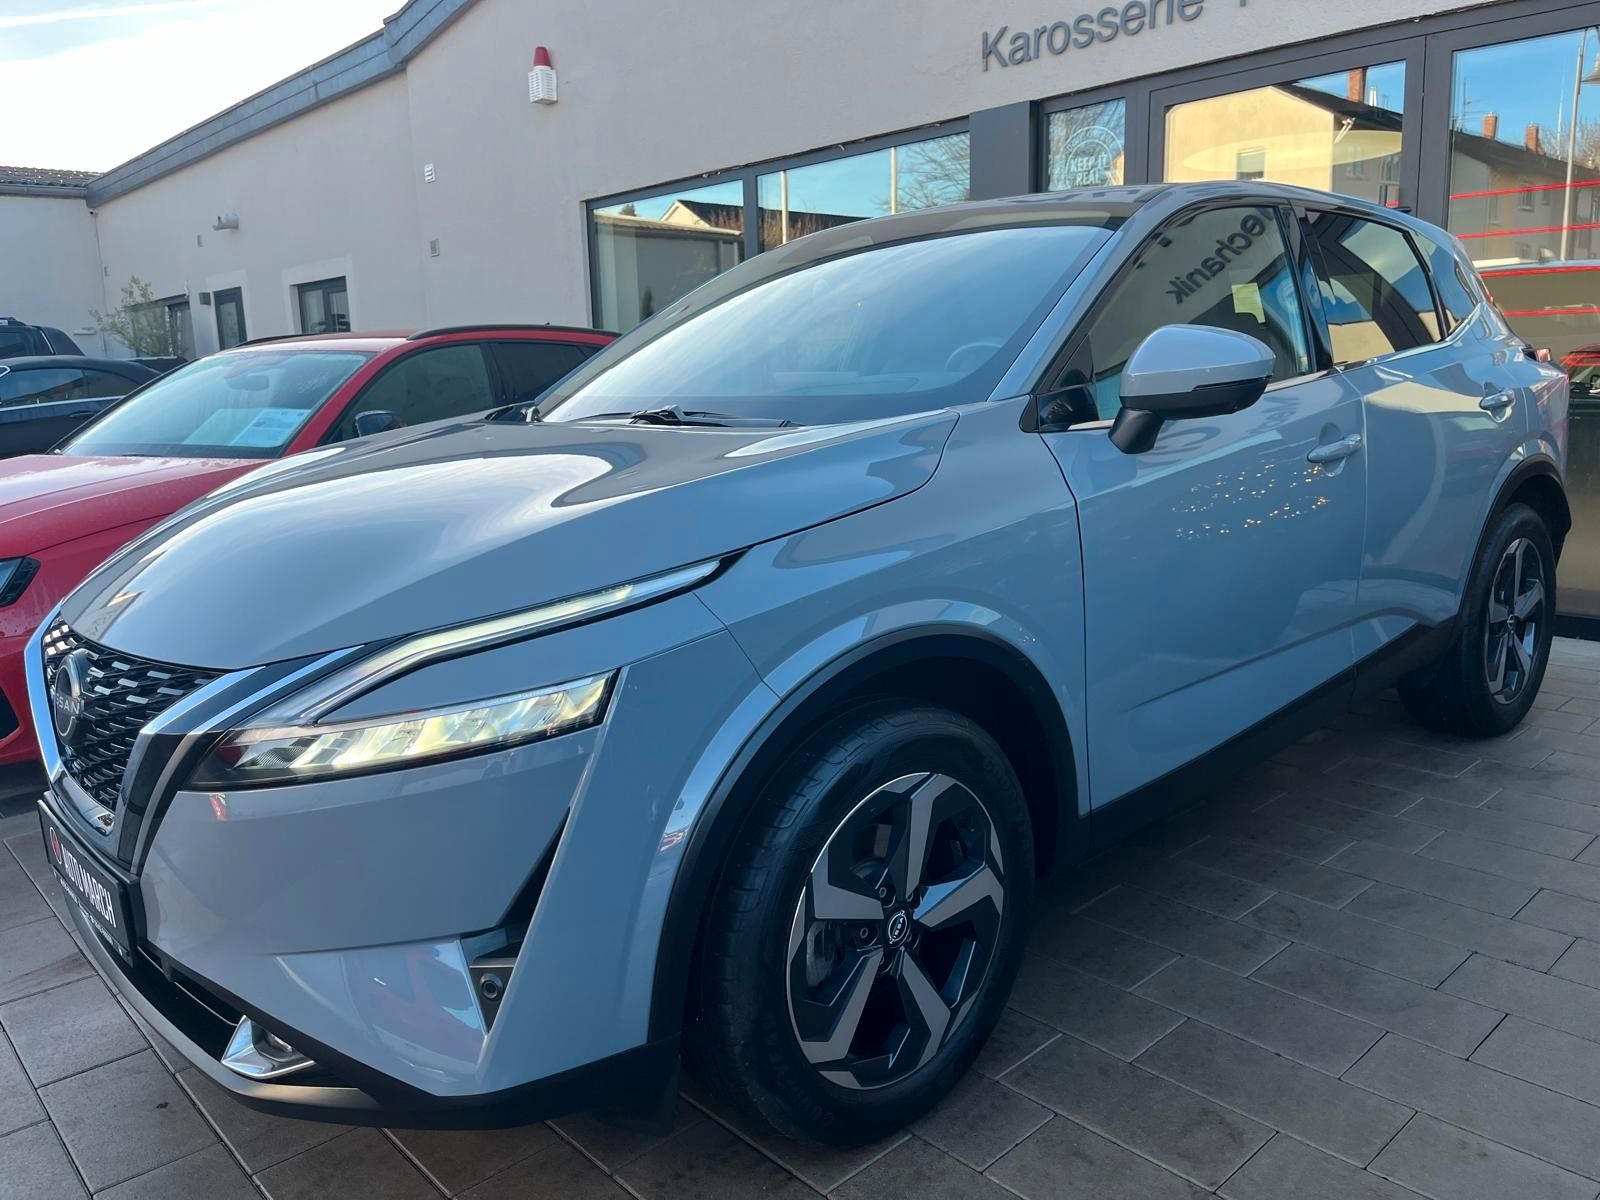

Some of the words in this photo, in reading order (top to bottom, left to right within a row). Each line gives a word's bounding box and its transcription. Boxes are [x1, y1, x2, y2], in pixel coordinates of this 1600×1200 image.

[981, 0, 1204, 71] Karosserie
[1071, 156, 1095, 172] KEEP
[1098, 151, 1108, 169] IT
[1076, 171, 1102, 185] REAL
